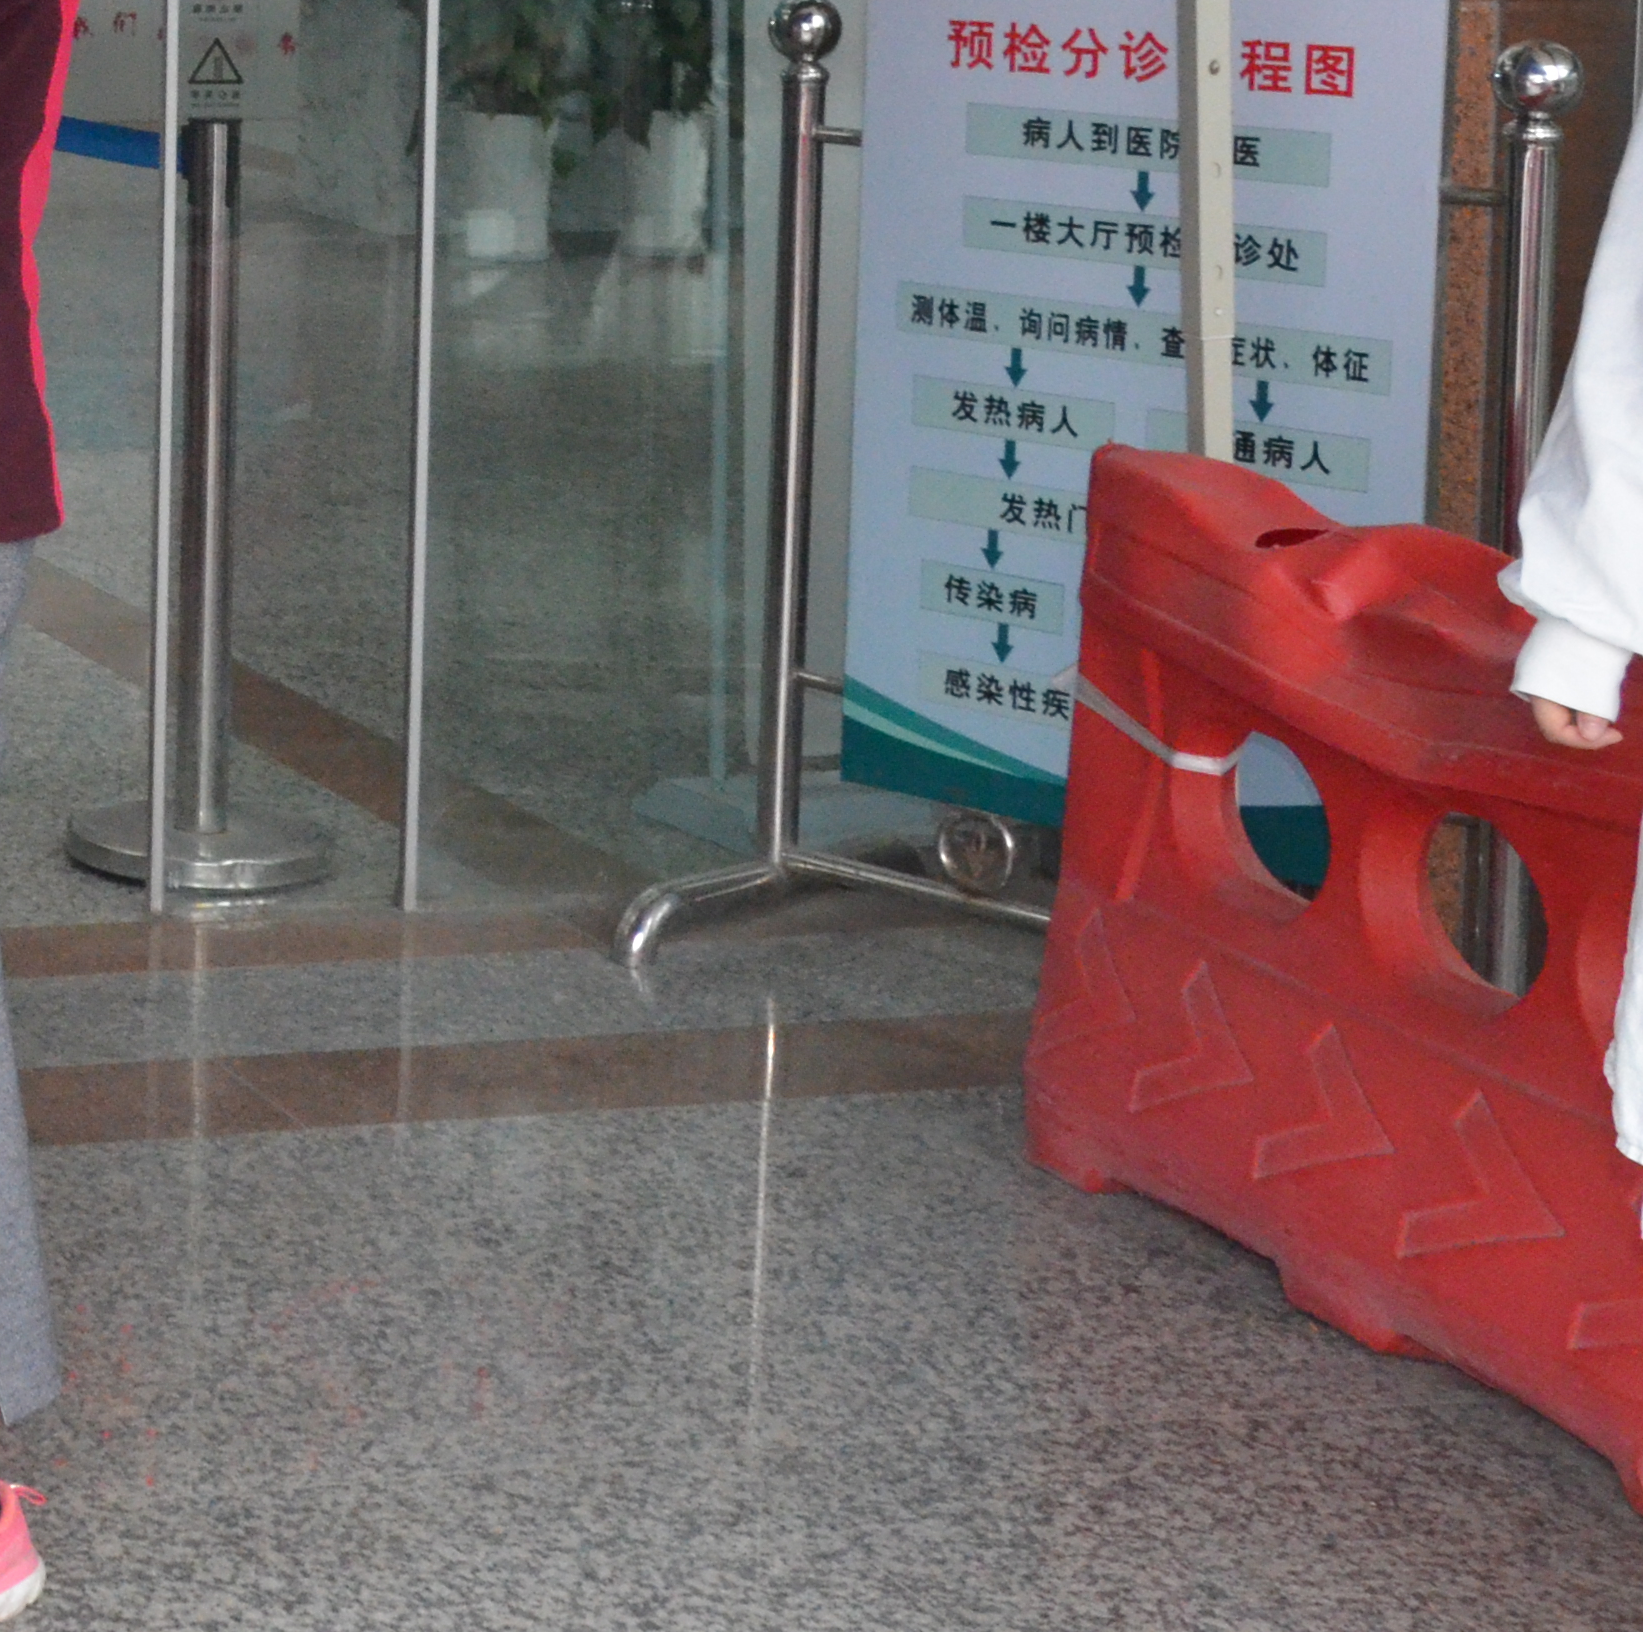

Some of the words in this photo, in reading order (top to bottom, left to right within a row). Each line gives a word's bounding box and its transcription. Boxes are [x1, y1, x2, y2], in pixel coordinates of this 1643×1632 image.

[948, 20, 1355, 99] 预检分诊程图
[1022, 117, 1261, 168] 病人到医院医
[990, 212, 1300, 273] 一楼大厅预检诊处
[911, 294, 1369, 383] 测体温、询问病情、查症状、体征
[952, 390, 1079, 438] 发热病人
[1232, 430, 1331, 475] 通病人
[944, 573, 1037, 620] 传染病
[944, 668, 1071, 722] 感染性疾
